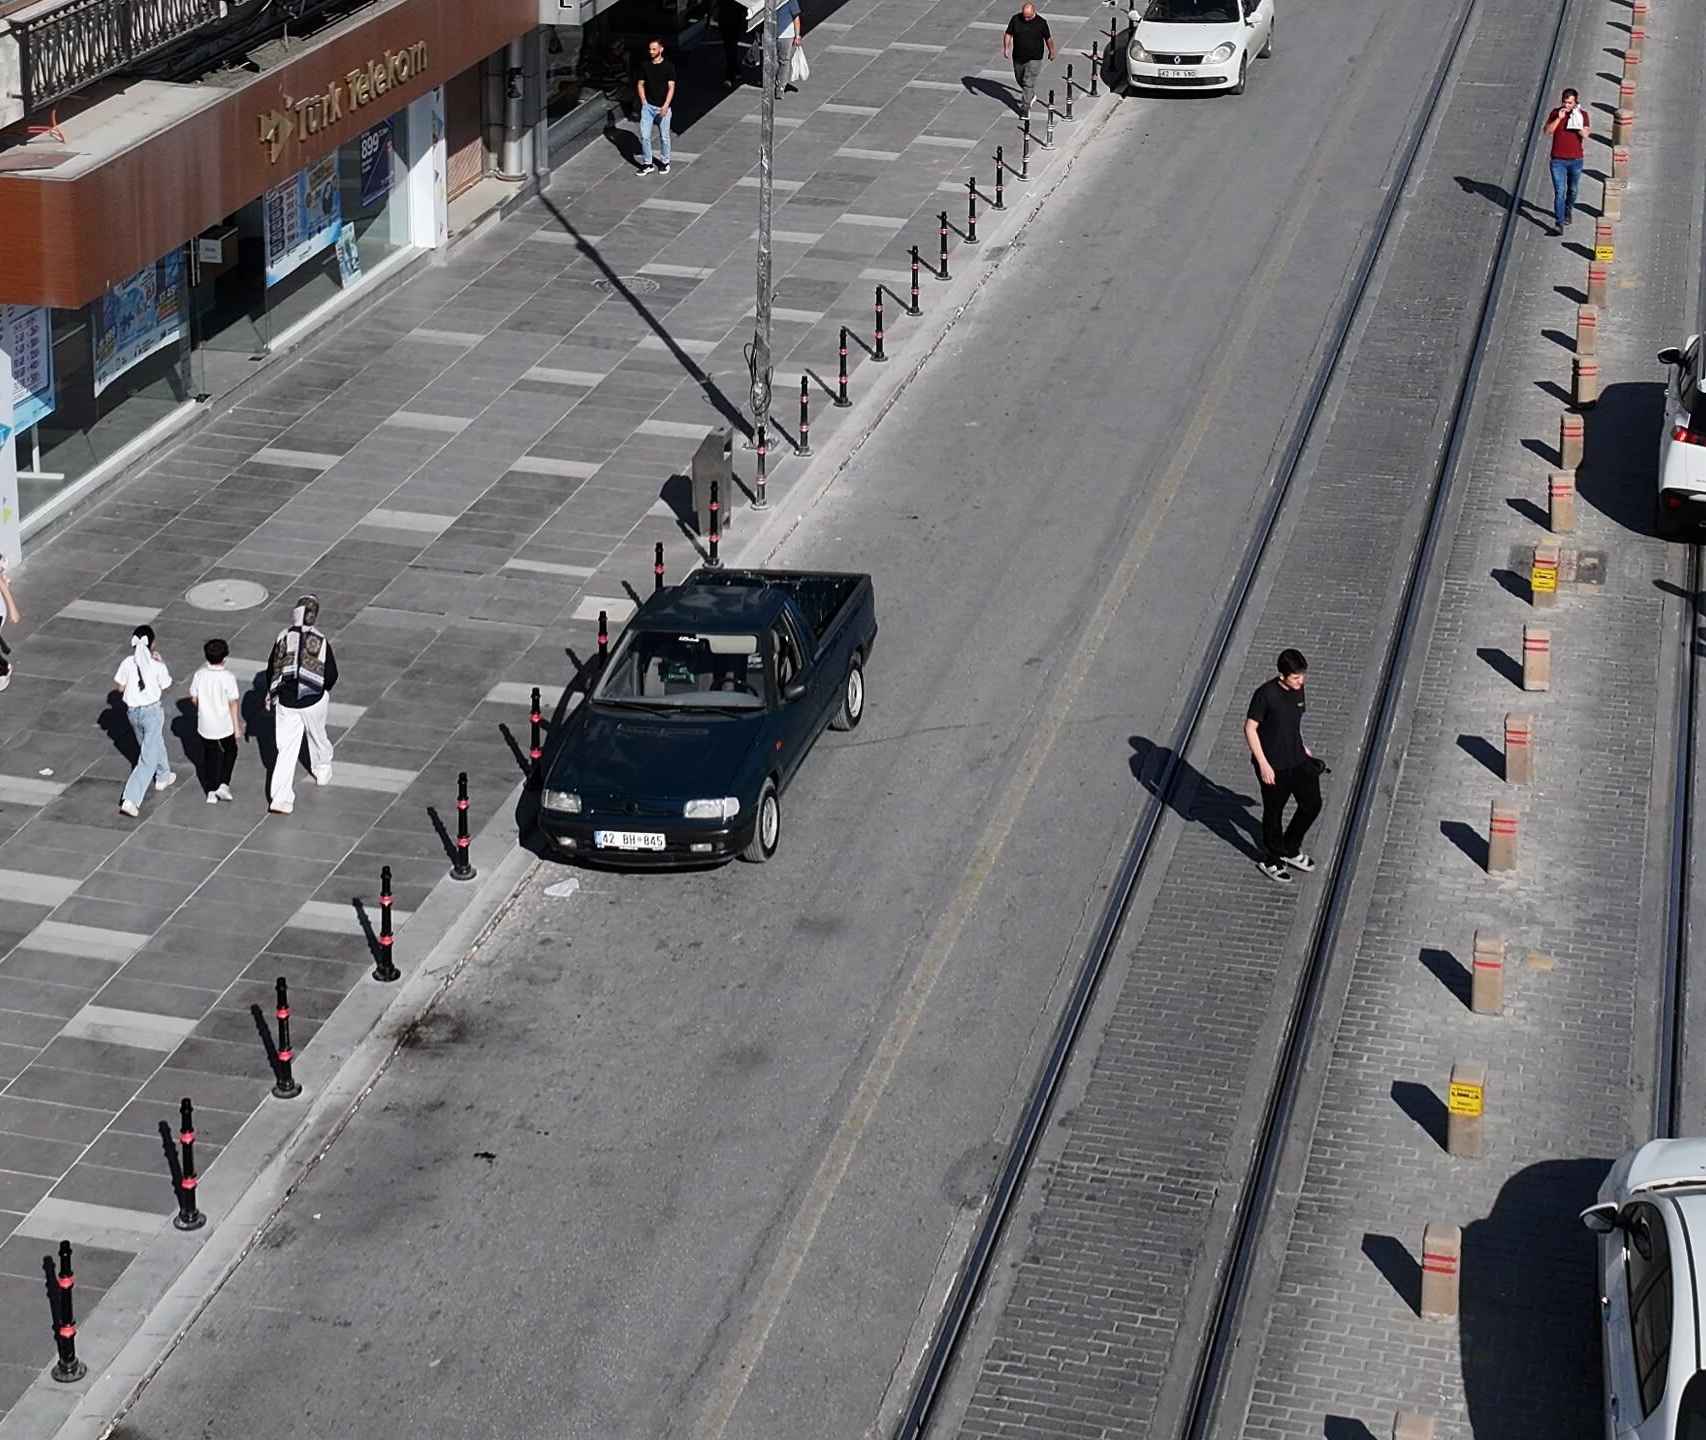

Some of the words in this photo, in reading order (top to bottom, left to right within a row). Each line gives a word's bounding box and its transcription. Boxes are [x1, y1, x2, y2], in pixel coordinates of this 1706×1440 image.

[293, 81, 343, 142] Türk
[344, 40, 429, 111] Telekom
[361, 133, 379, 160] 899
[602, 834, 615, 845] 42
[622, 835, 636, 845] BH
[643, 836, 663, 847] 845
